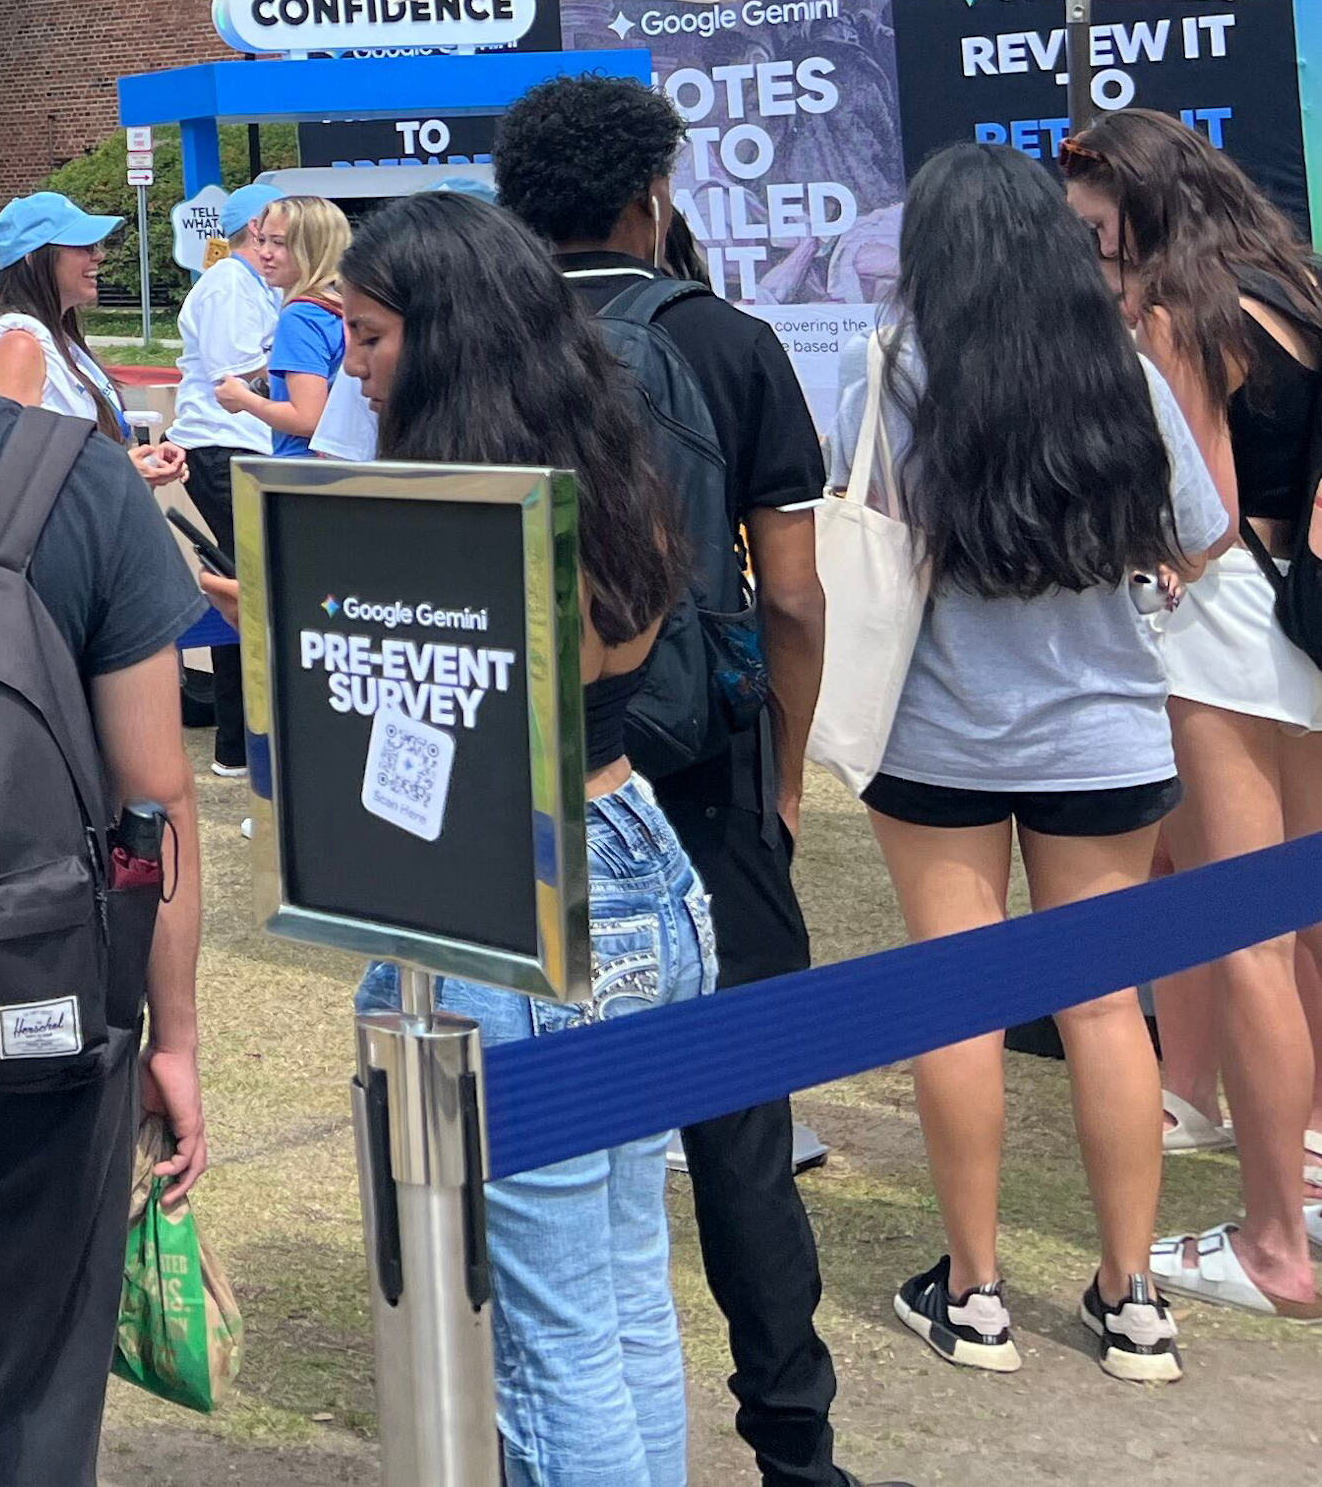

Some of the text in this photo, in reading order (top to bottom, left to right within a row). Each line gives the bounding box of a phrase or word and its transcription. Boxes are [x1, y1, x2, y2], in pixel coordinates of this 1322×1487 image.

[641, 6, 737, 38] Google
[961, 14, 1236, 77] REVEW IT
[650, 57, 839, 123] OTES
[1055, 69, 1135, 111] O
[396, 119, 451, 155] TO
[685, 124, 775, 181] TO
[182, 218, 218, 229] WHAT
[191, 207, 219, 218] TELL
[672, 182, 858, 241] AILED
[196, 229, 226, 240] THIN
[706, 245, 768, 301] IT
[774, 318, 868, 335] covering the
[794, 340, 839, 353] based
[343, 597, 489, 631] Google Gemini
[300, 630, 515, 691] PRE-EVENT
[328, 672, 485, 729] SURVEY
[373, 790, 400, 813] Scan
